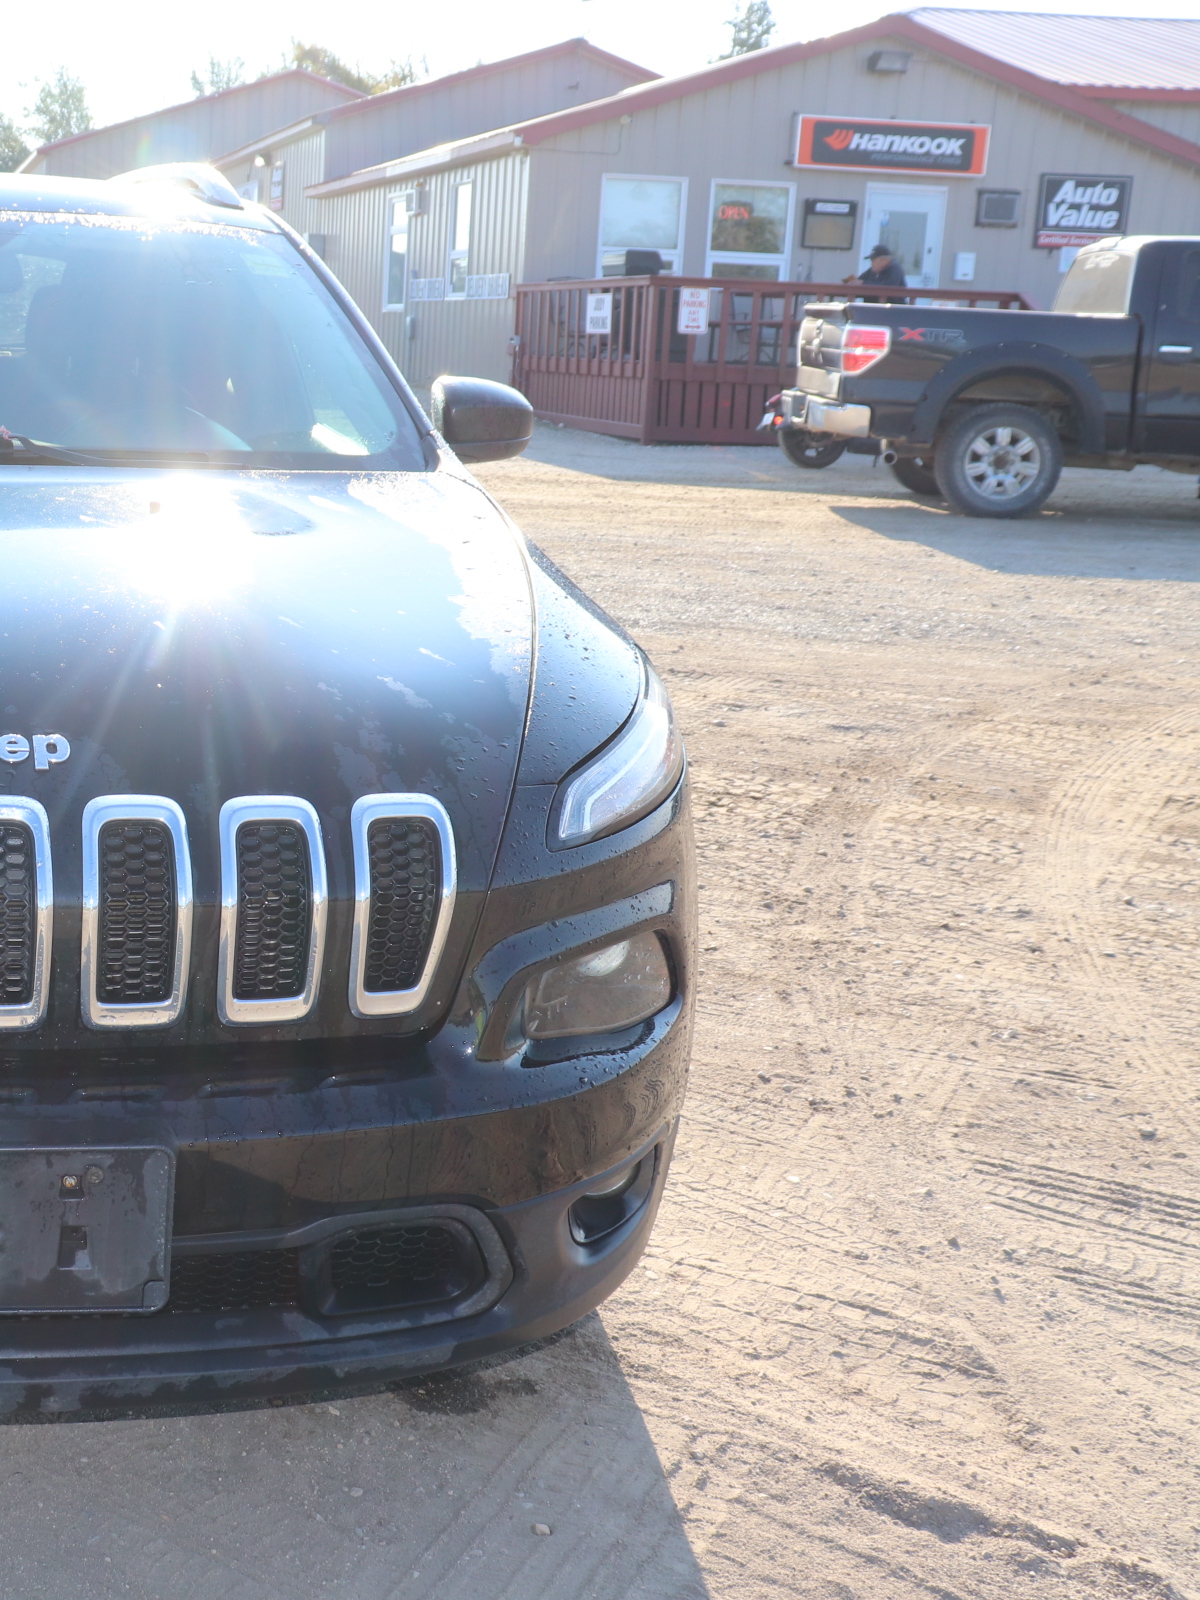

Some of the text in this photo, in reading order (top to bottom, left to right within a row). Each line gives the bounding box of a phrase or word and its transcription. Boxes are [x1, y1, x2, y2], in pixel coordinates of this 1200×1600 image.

[1052, 179, 1120, 206] Auto
[718, 205, 749, 219] OPEN
[1046, 203, 1120, 229] Value
[690, 290, 701, 299] NO
[683, 300, 707, 308] PARKING
[590, 315, 608, 330] PARKING
[898, 326, 966, 343] XTR
